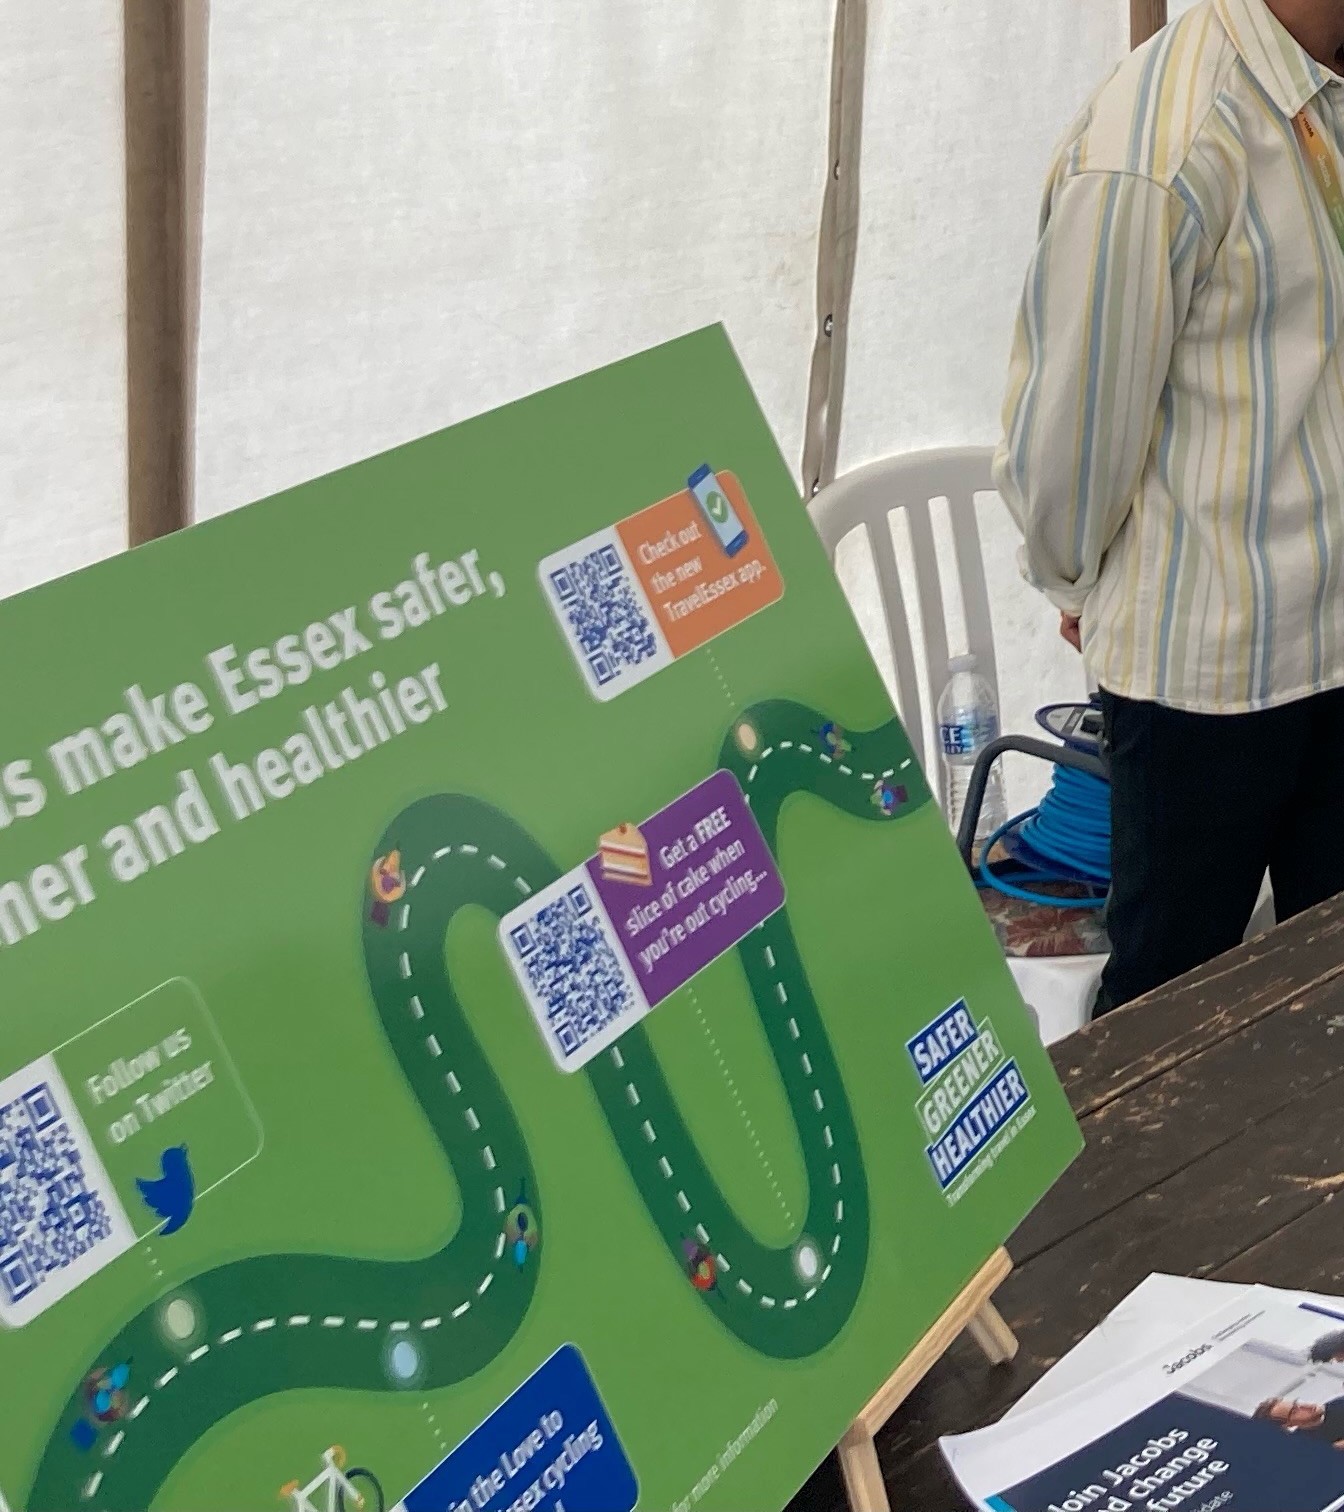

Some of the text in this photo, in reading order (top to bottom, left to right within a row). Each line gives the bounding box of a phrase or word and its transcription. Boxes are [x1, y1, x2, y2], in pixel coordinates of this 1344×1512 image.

[637, 520, 702, 565] Check out
[652, 556, 702, 594] the new
[47, 684, 214, 795] make
[205, 642, 374, 715] Essex
[369, 549, 506, 641] safer,
[101, 769, 221, 883] and
[209, 662, 449, 821] healthier
[659, 805, 732, 870] Get a FREE
[625, 839, 745, 937] slice of cake when
[638, 869, 768, 974] you're out cycling...
[87, 1027, 192, 1104] Follow us
[913, 1008, 975, 1077] SAFER
[110, 1060, 214, 1143] on Twitter
[923, 1029, 999, 1135] GREENER
[931, 1068, 1026, 1182] HEALTHIER
[1162, 1343, 1214, 1375] Jacobs
[470, 1410, 563, 1508] the Love to
[540, 1419, 604, 1489] cycling
[716, 1398, 778, 1471] information
[1102, 1427, 1190, 1487] Jacobs
[1128, 1437, 1218, 1500] change
[1146, 1459, 1230, 1512] future
